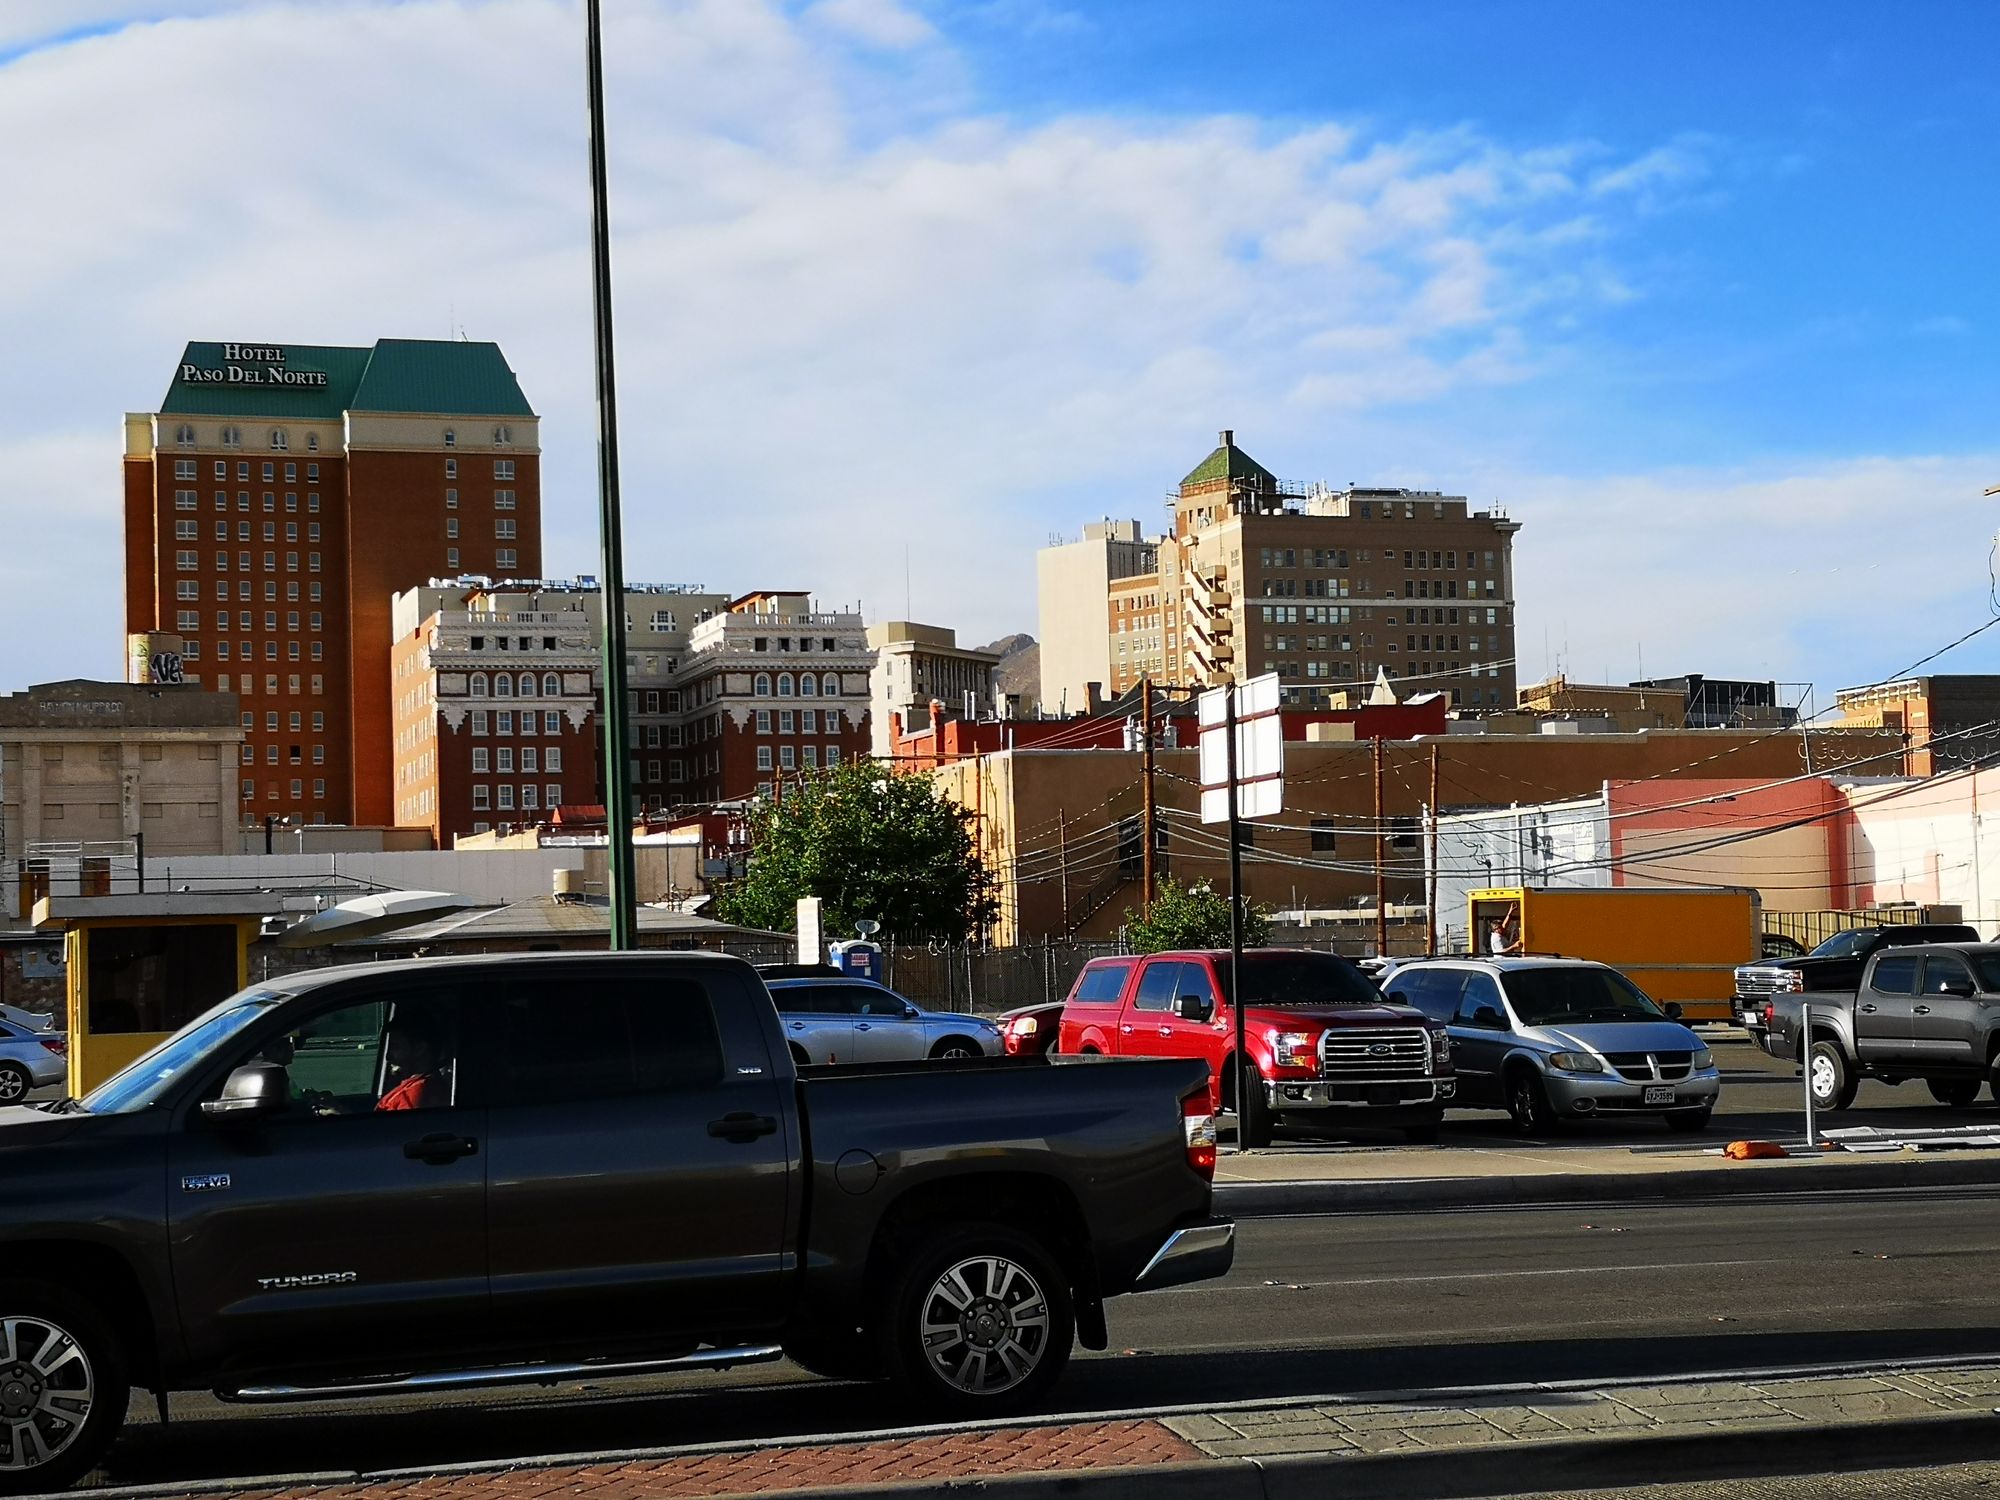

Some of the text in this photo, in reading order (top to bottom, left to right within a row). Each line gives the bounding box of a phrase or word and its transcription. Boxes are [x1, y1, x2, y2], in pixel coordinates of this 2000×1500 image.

[223, 343, 284, 361] HOTEL
[182, 364, 327, 385] PASO DEL NORTE
[257, 1271, 357, 1289] TUNDRA
